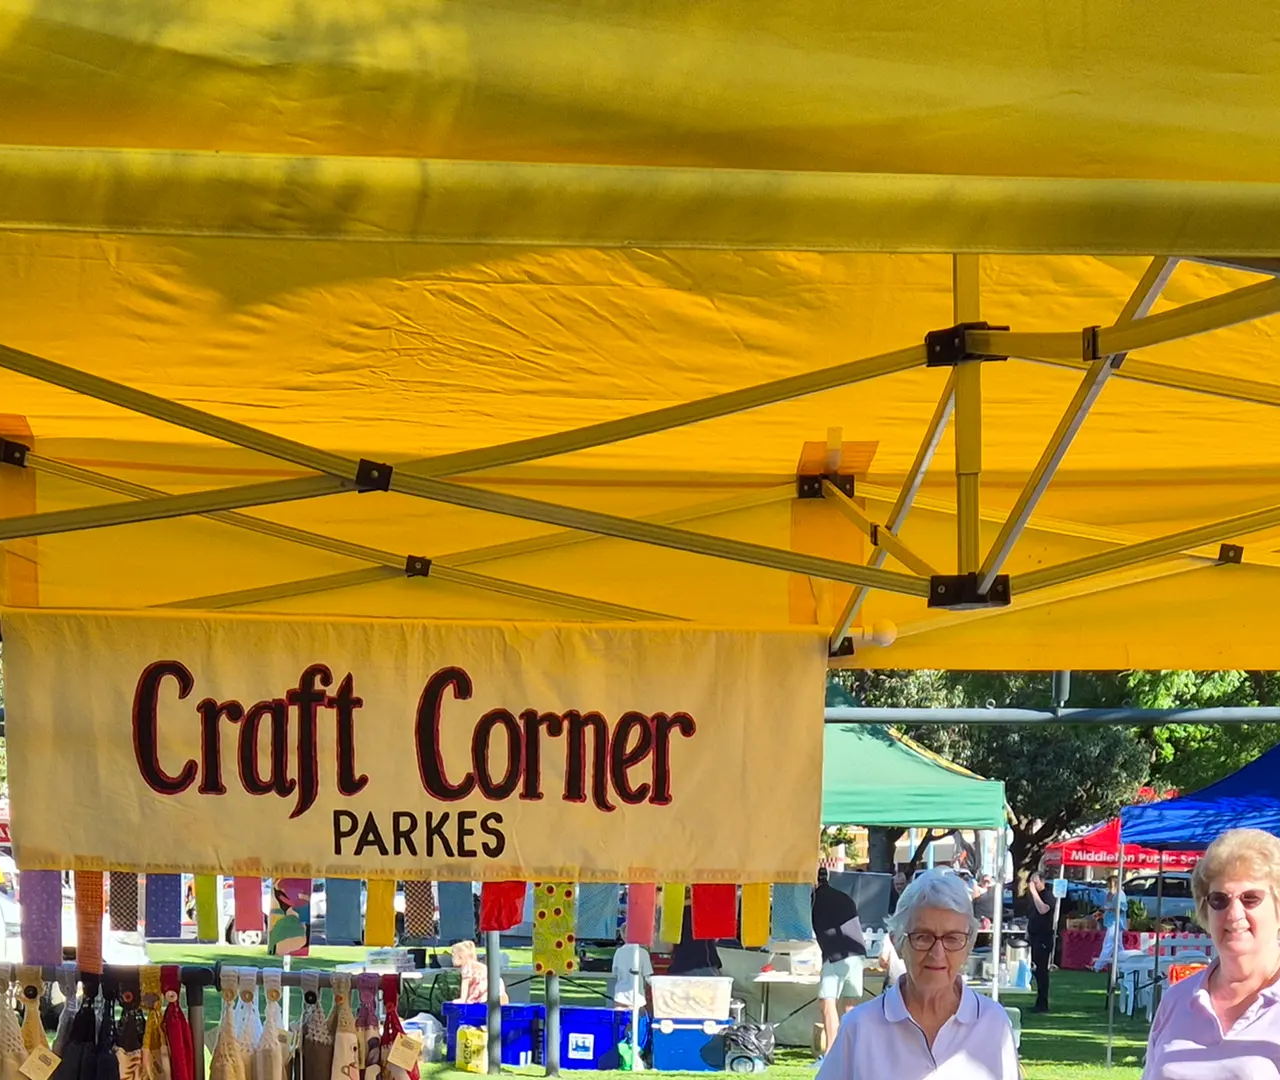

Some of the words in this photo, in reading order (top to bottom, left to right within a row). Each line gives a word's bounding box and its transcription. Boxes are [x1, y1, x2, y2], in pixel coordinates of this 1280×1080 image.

[132, 659, 370, 819] Craft
[415, 666, 697, 812] Corner
[333, 810, 507, 858] PARKES
[1070, 850, 1135, 863] Middleton
[1180, 854, 1205, 865] Sch
